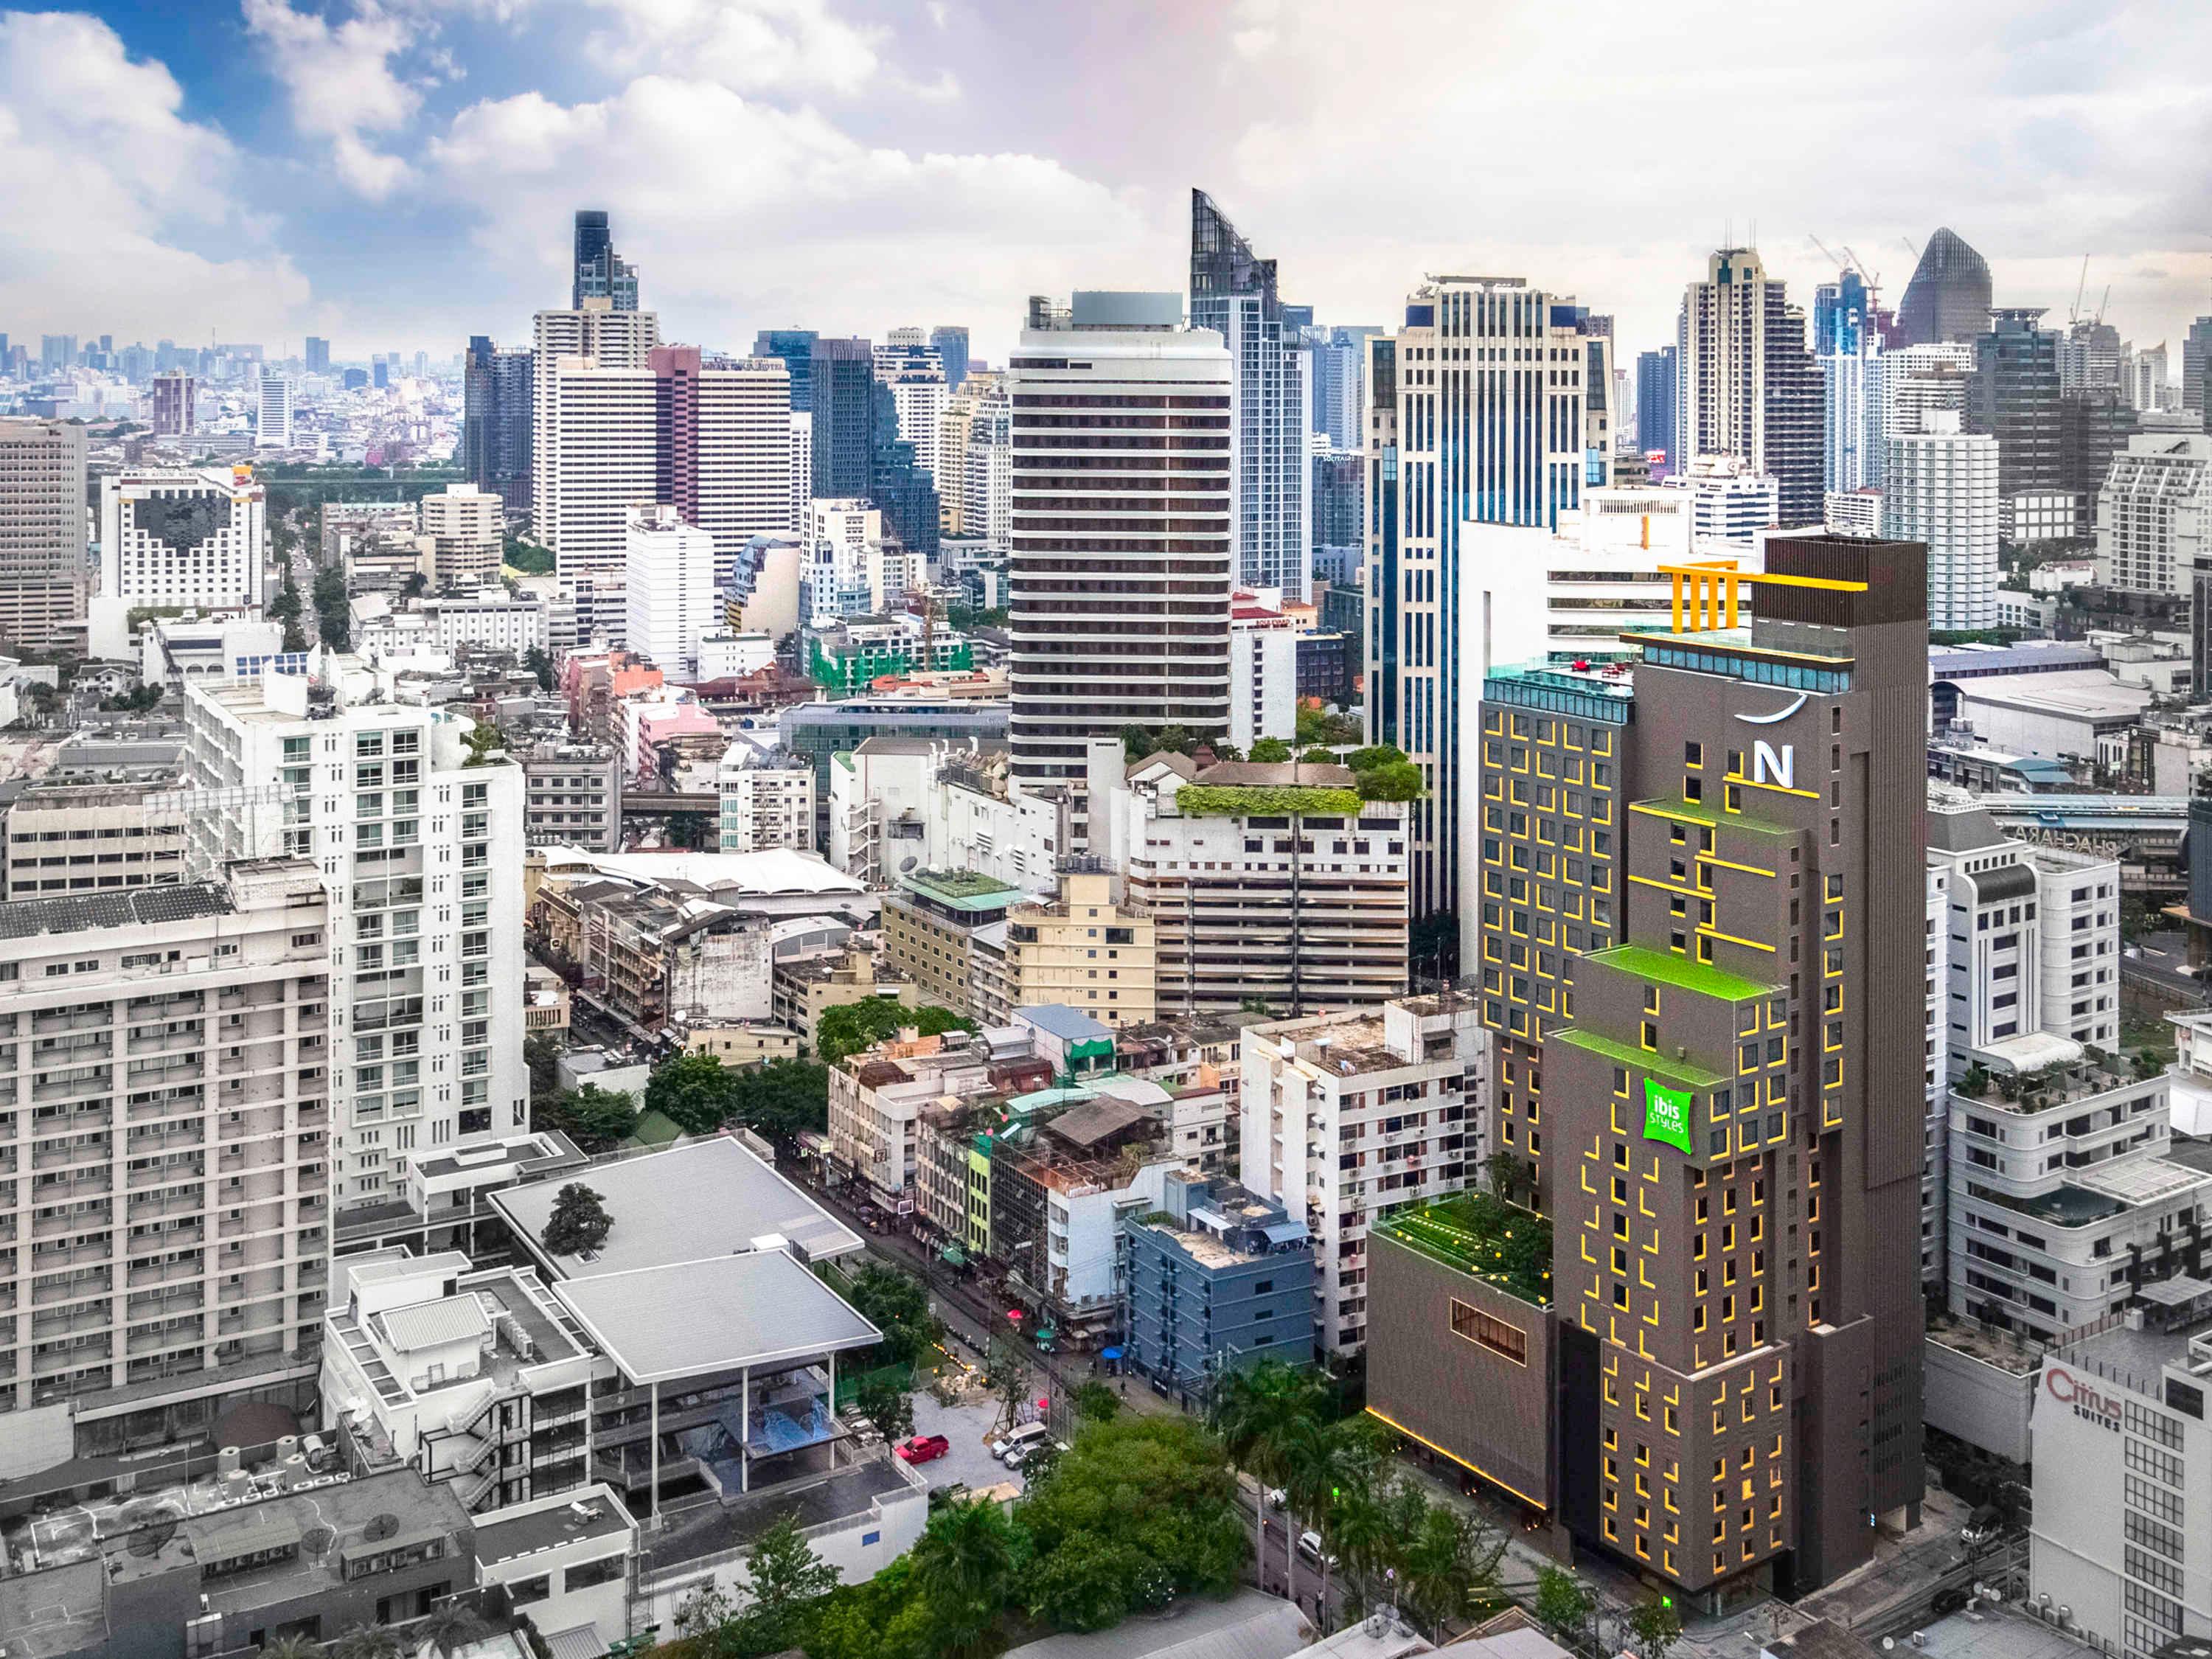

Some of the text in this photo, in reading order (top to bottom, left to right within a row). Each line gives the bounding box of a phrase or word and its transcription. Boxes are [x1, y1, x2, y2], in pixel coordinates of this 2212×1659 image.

[1753, 740, 1794, 789] N
[1653, 1094, 1680, 1120] ibis
[2046, 1368, 2123, 1420] Citrus
[2073, 1404, 2121, 1433] SUITES
